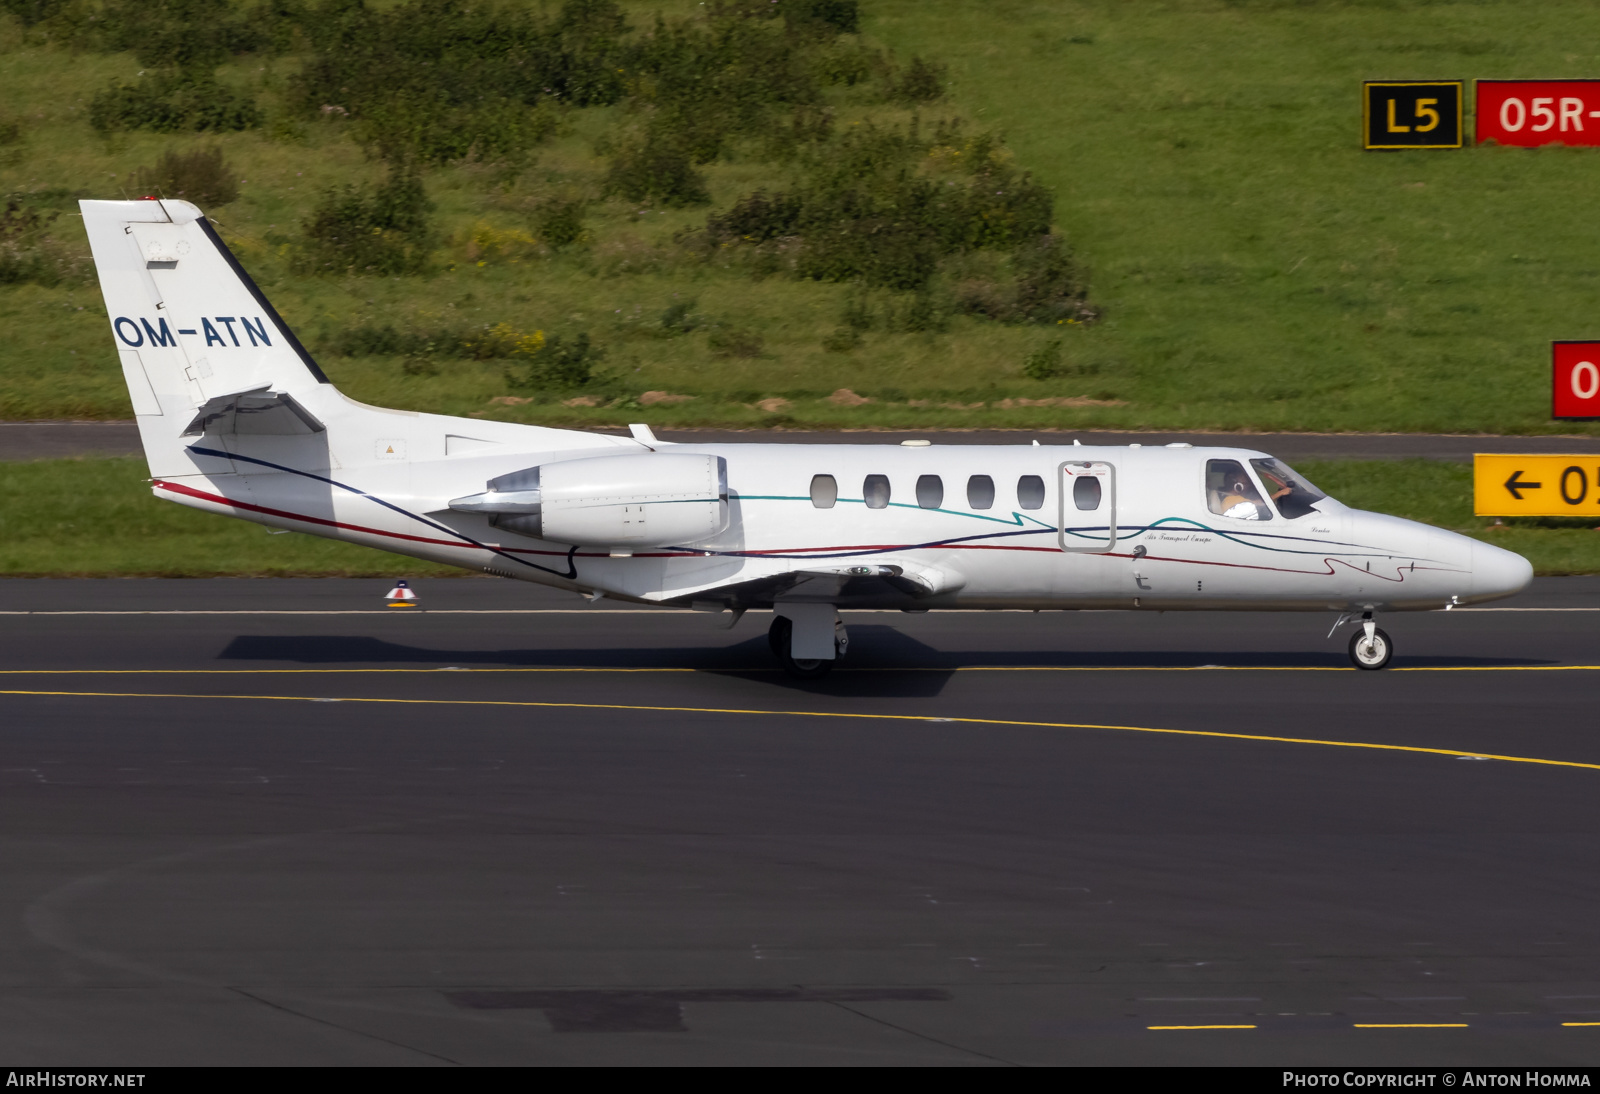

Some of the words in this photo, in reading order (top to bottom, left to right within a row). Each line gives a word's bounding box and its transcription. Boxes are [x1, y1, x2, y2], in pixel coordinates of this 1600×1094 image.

[1387, 98, 1440, 133] L5
[114, 316, 272, 347] OM-ATN
[1560, 465, 1600, 505] 0
[1144, 533, 1157, 541] Air
[1159, 533, 1189, 543] Transport
[1190, 534, 1212, 544] Europe
